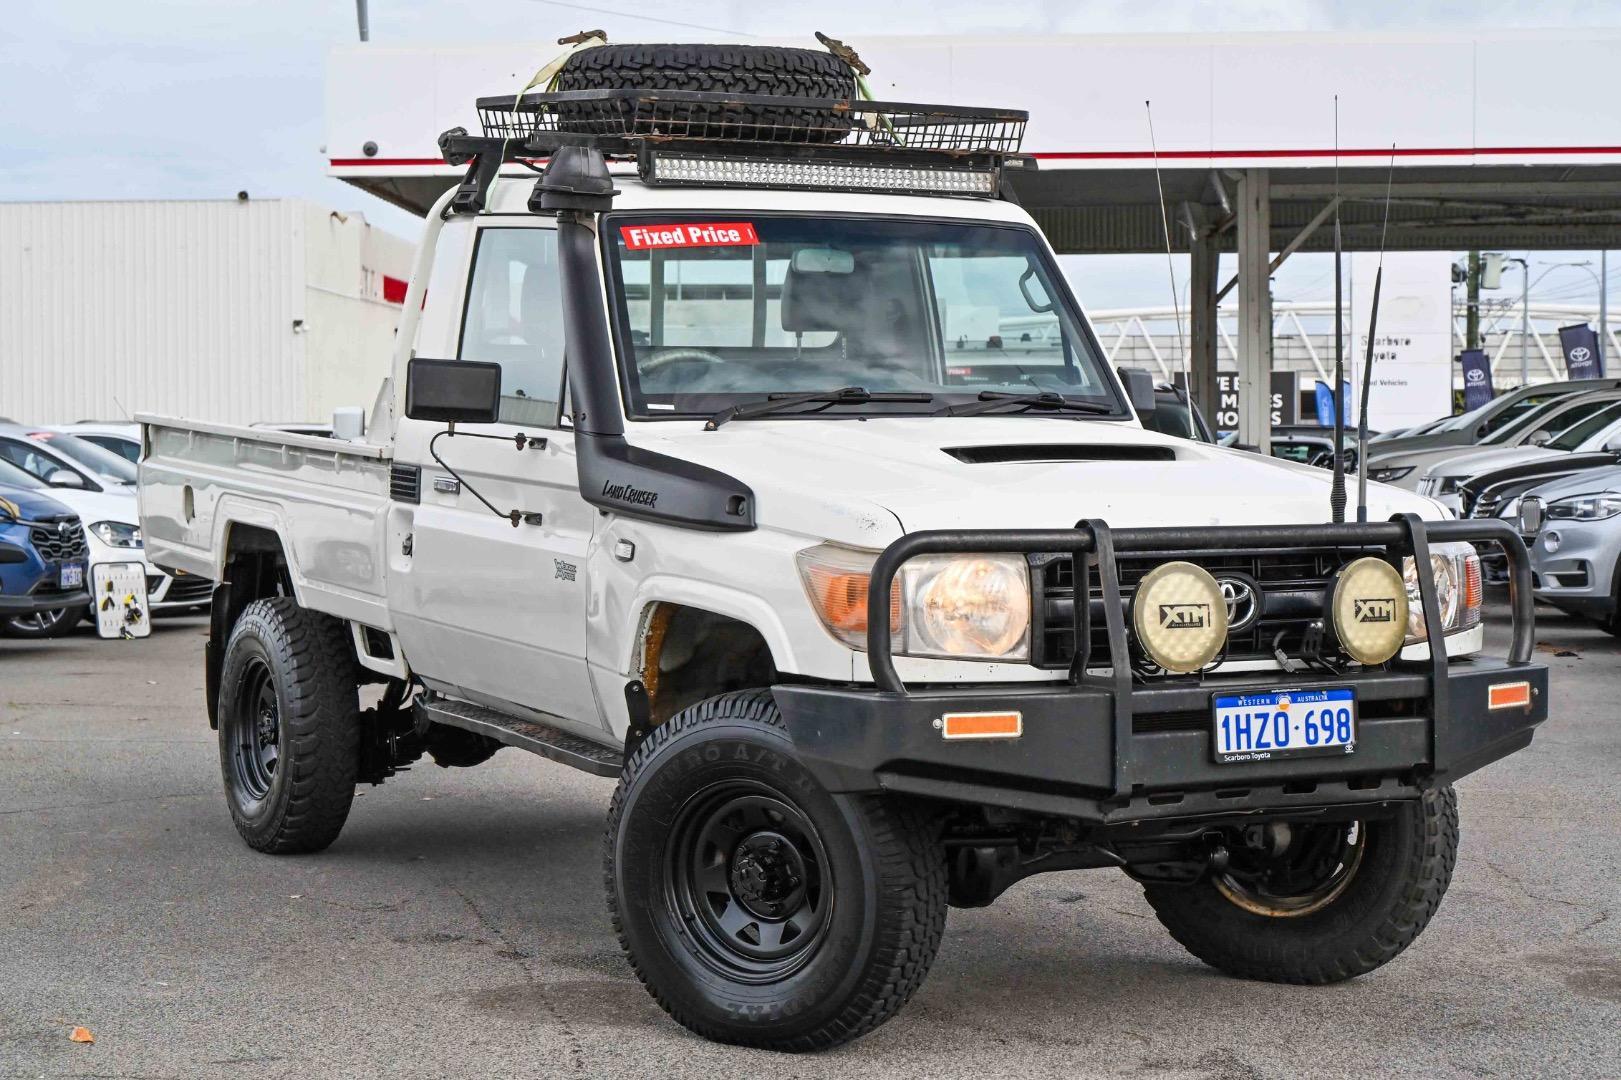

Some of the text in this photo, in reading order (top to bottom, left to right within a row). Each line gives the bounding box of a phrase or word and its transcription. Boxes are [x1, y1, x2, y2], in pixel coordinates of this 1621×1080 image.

[629, 227, 686, 246] Fixed
[688, 226, 741, 243] Price
[1361, 335, 1411, 346] Sarboro
[1361, 349, 1397, 363] Tyota
[1380, 379, 1408, 387] Vehicles
[1160, 605, 1209, 628] XTM
[1355, 600, 1395, 622] XTM
[1237, 693, 1328, 706] WESTERN AUSTRALIA
[1224, 752, 1271, 762] Scarboro Toyota
